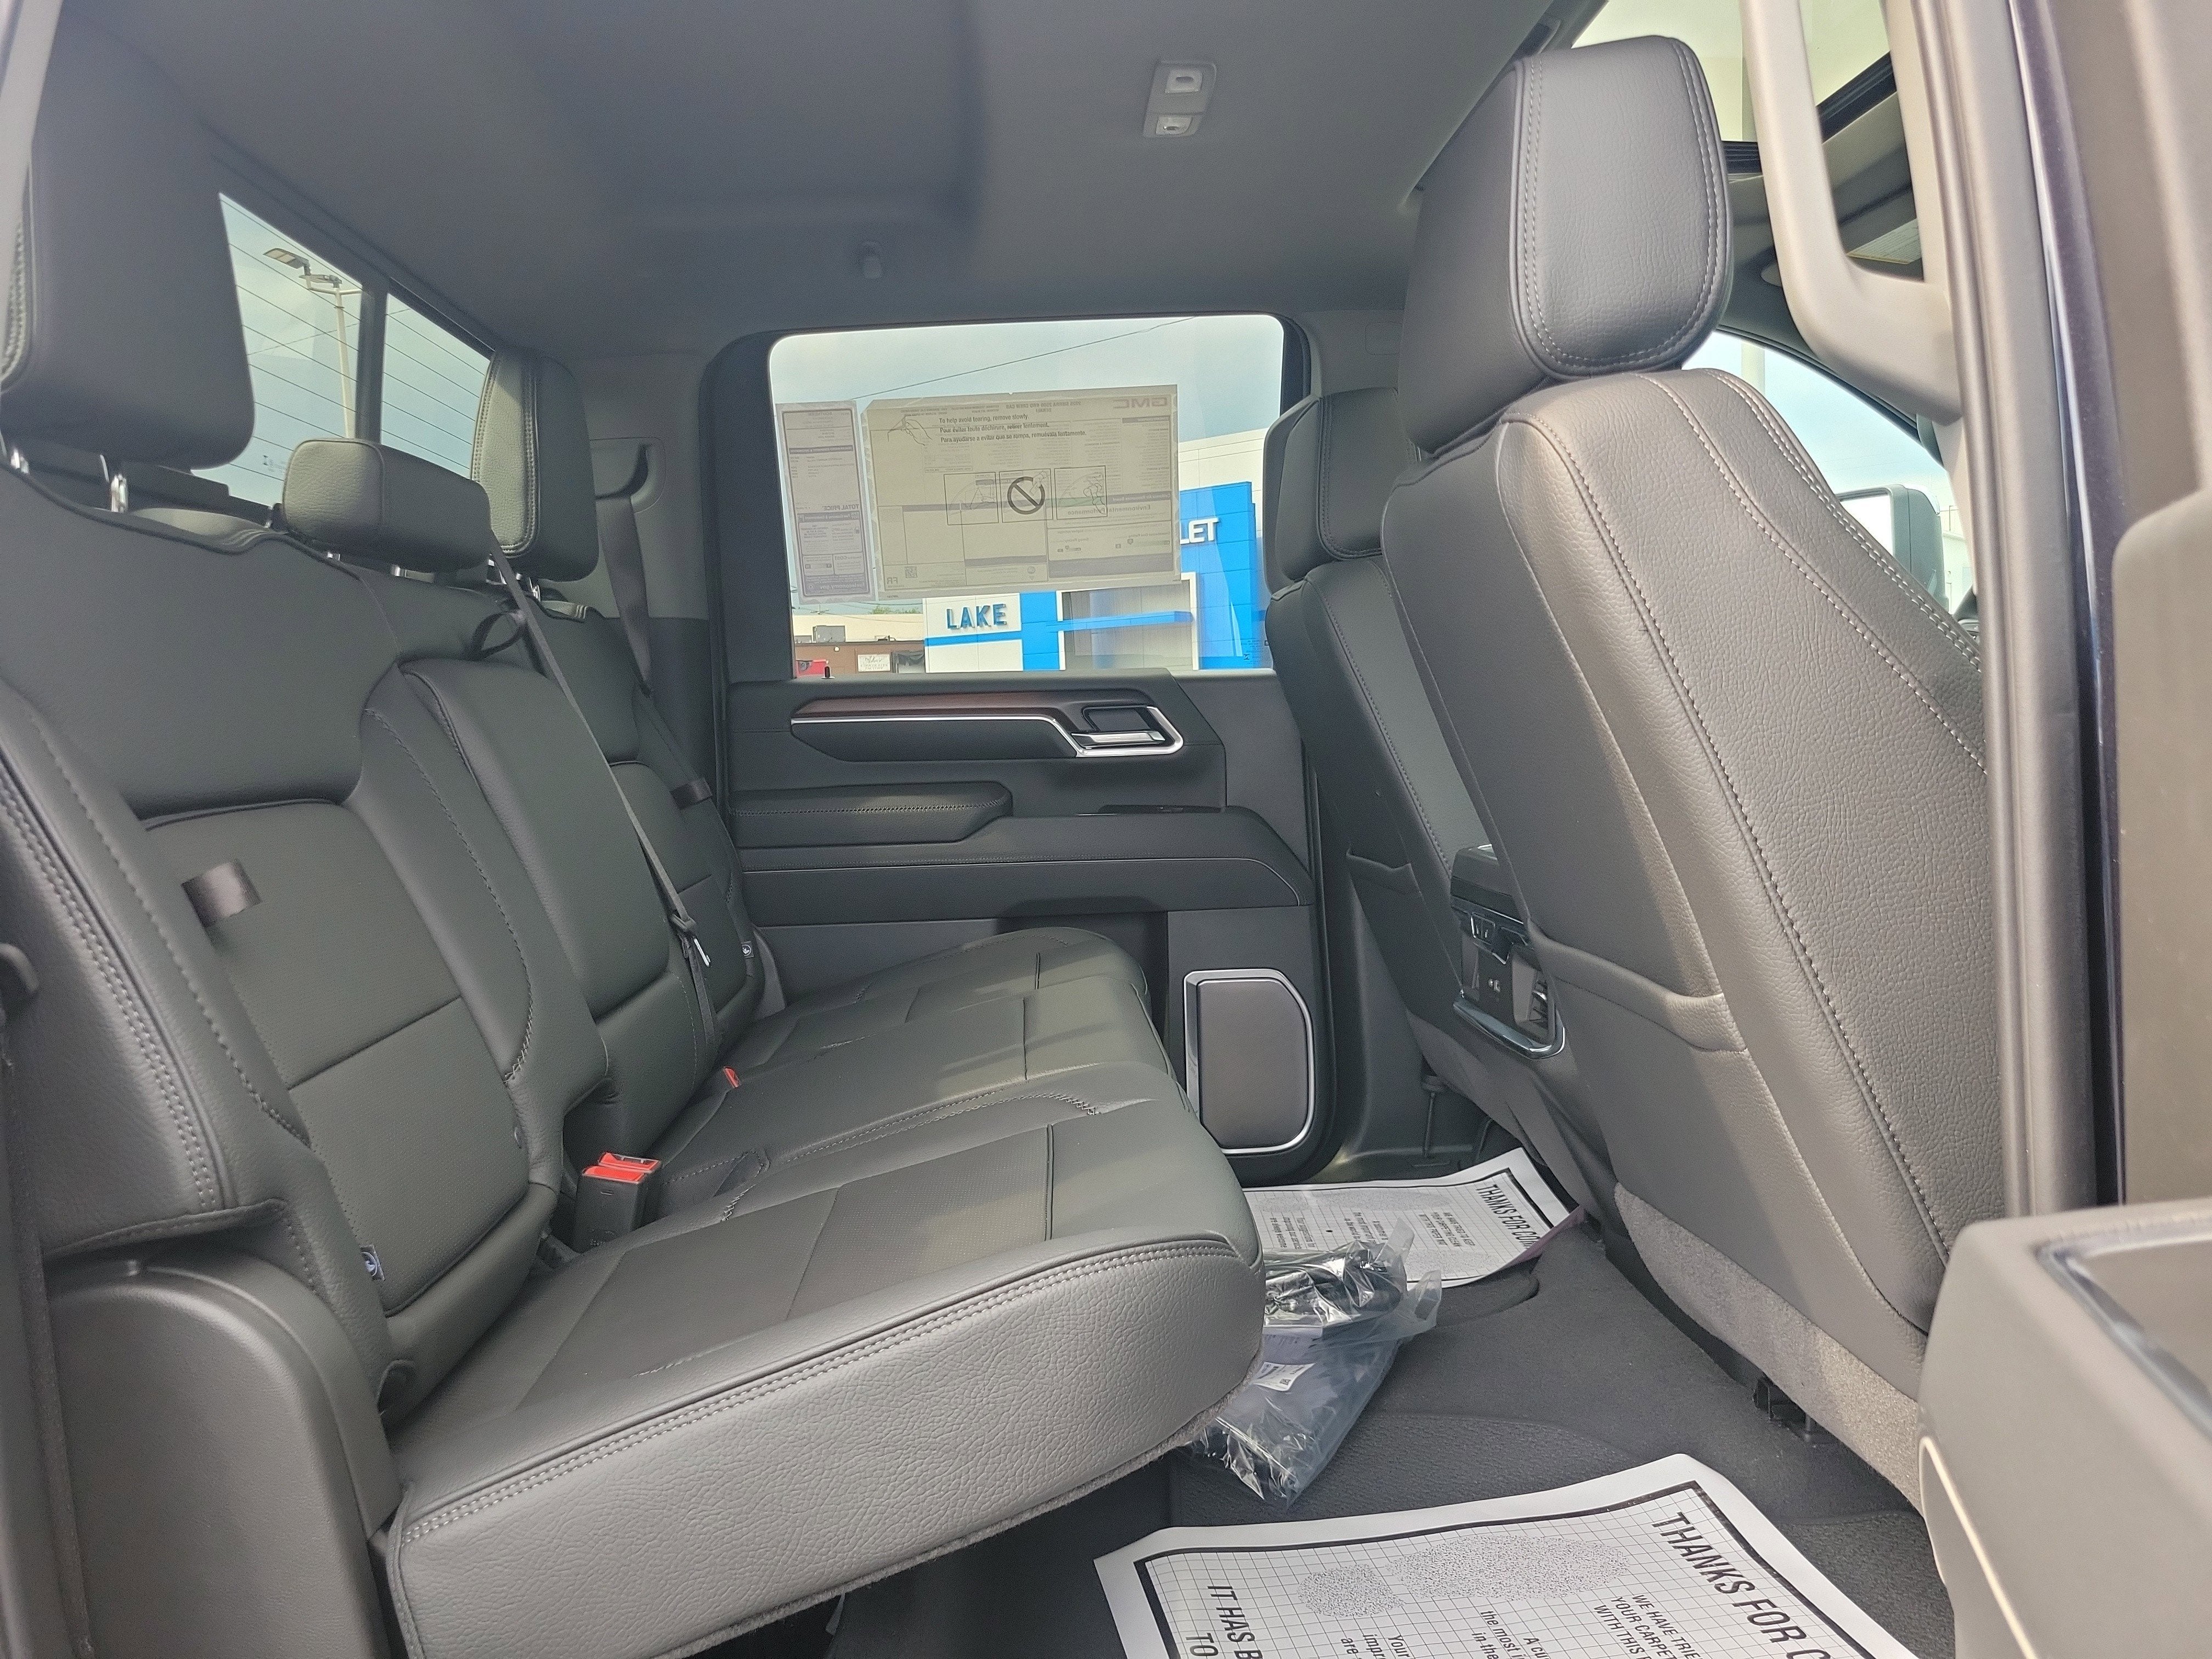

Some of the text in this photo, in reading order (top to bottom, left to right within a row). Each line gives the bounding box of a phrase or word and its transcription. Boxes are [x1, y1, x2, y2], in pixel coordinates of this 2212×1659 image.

[946, 603, 1007, 629] LAKE
[1476, 1184, 1517, 1214] THANKS
[1498, 1215, 1530, 1229] FOR
[1651, 1511, 1756, 1594] THANKS
[1732, 1599, 1807, 1643] FOR
[1207, 1585, 1238, 1601] IT
[1611, 1596, 1642, 1623] YOUR
[1216, 1607, 1255, 1643] HAS
[1480, 1610, 1499, 1626] the
[1492, 1628, 1521, 1652] most
[1594, 1605, 1624, 1630] WITH
[1616, 1631, 1645, 1655] THIS
[1632, 1594, 1703, 1659] WE HAVE TRIE
[1186, 1633, 1219, 1657] TO
[1340, 1638, 1359, 1654] are
[1363, 1634, 1386, 1659] impr
[1387, 1635, 1411, 1657] Your
[1471, 1632, 1499, 1659] in the
[1531, 1647, 1549, 1659] cu
